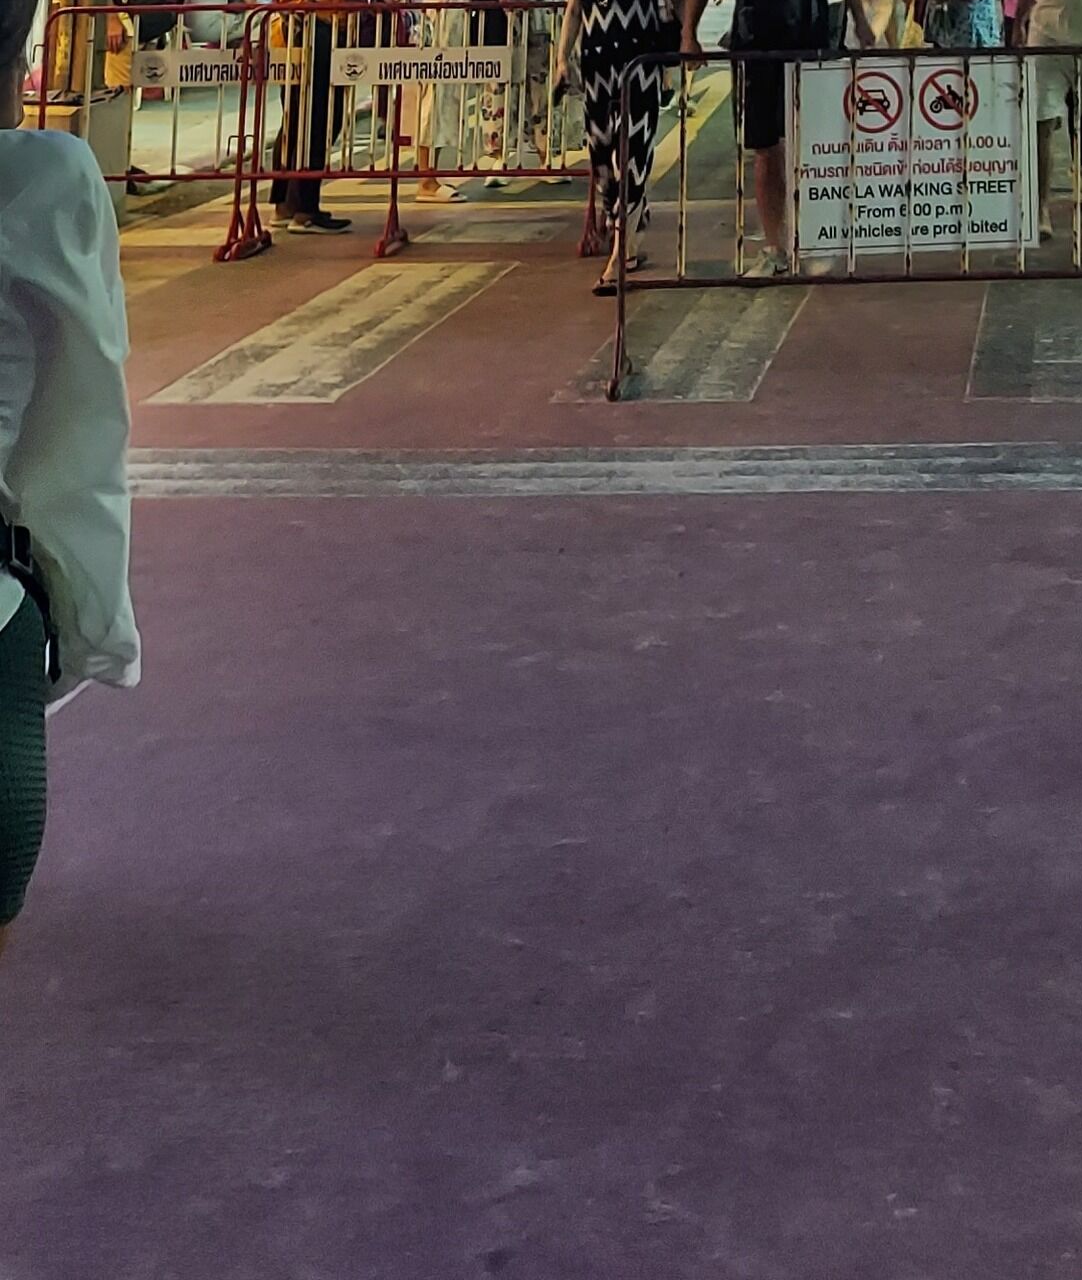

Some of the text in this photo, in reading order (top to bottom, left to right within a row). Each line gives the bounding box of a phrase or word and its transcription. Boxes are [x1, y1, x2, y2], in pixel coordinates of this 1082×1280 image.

[879, 182, 953, 198] WAKING
[818, 225, 837, 240] All
[841, 224, 902, 239] vhicles
